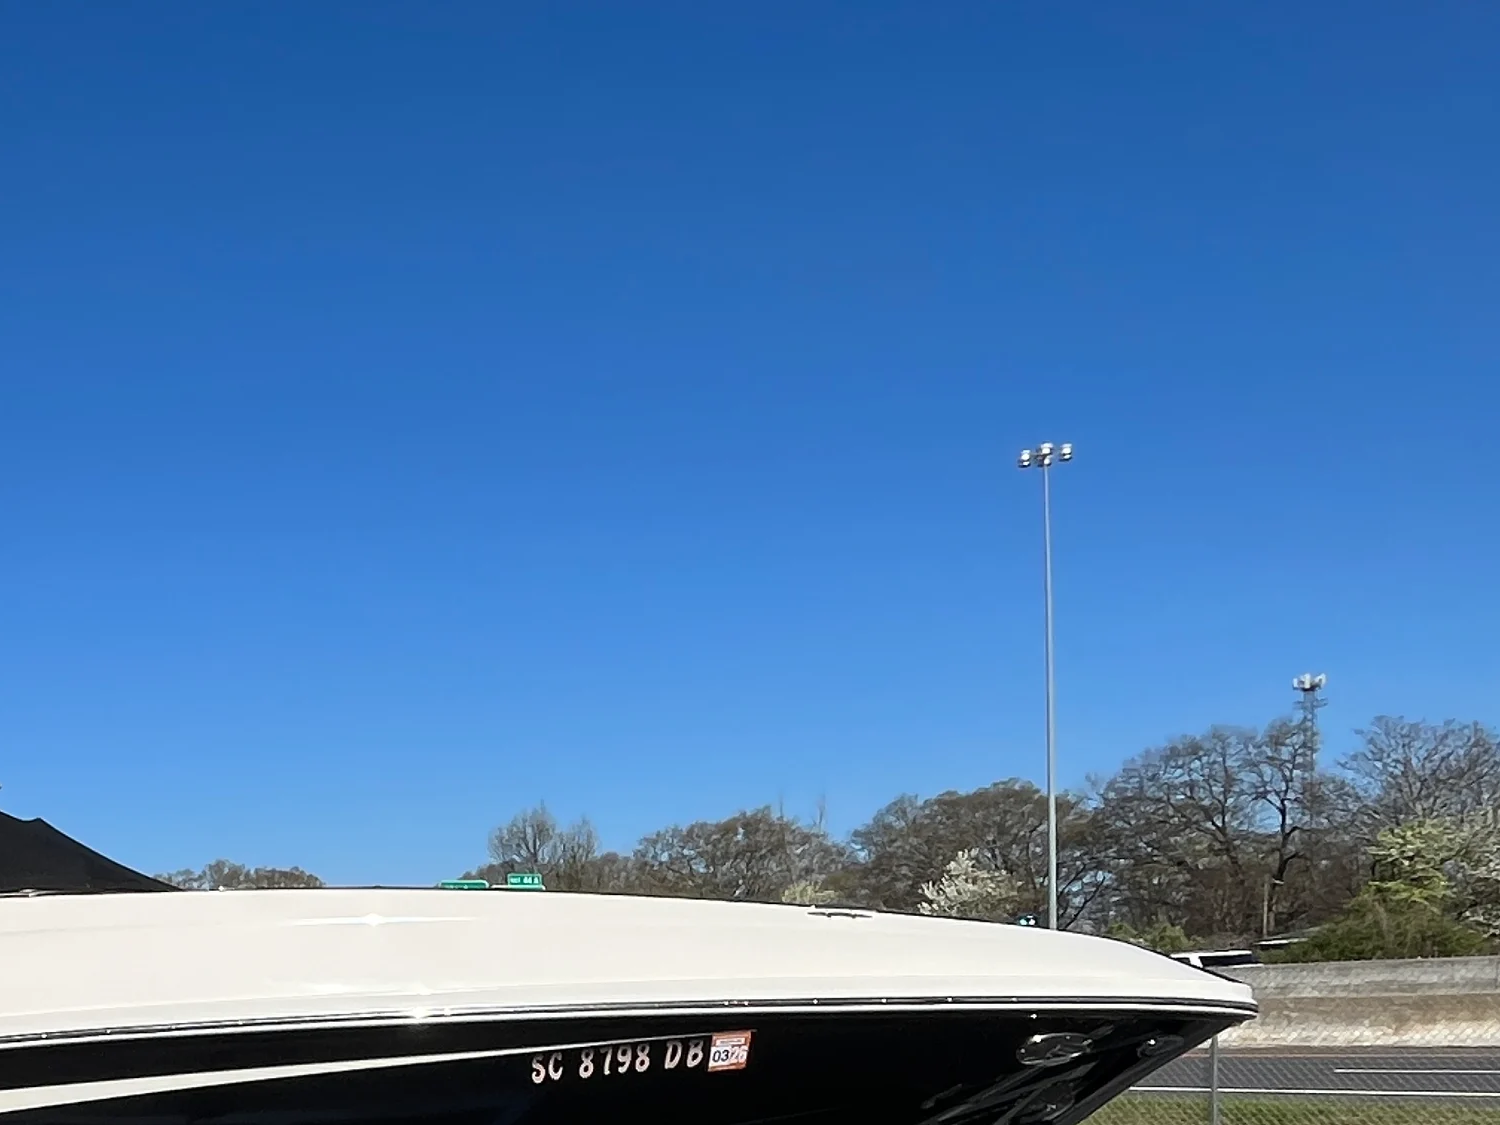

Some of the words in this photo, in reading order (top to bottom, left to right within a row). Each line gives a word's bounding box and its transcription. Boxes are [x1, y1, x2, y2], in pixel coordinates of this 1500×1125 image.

[531, 1052, 564, 1084] SC
[579, 1043, 650, 1079] 8798
[664, 1040, 704, 1069] DB
[712, 1049, 729, 1062] 03
